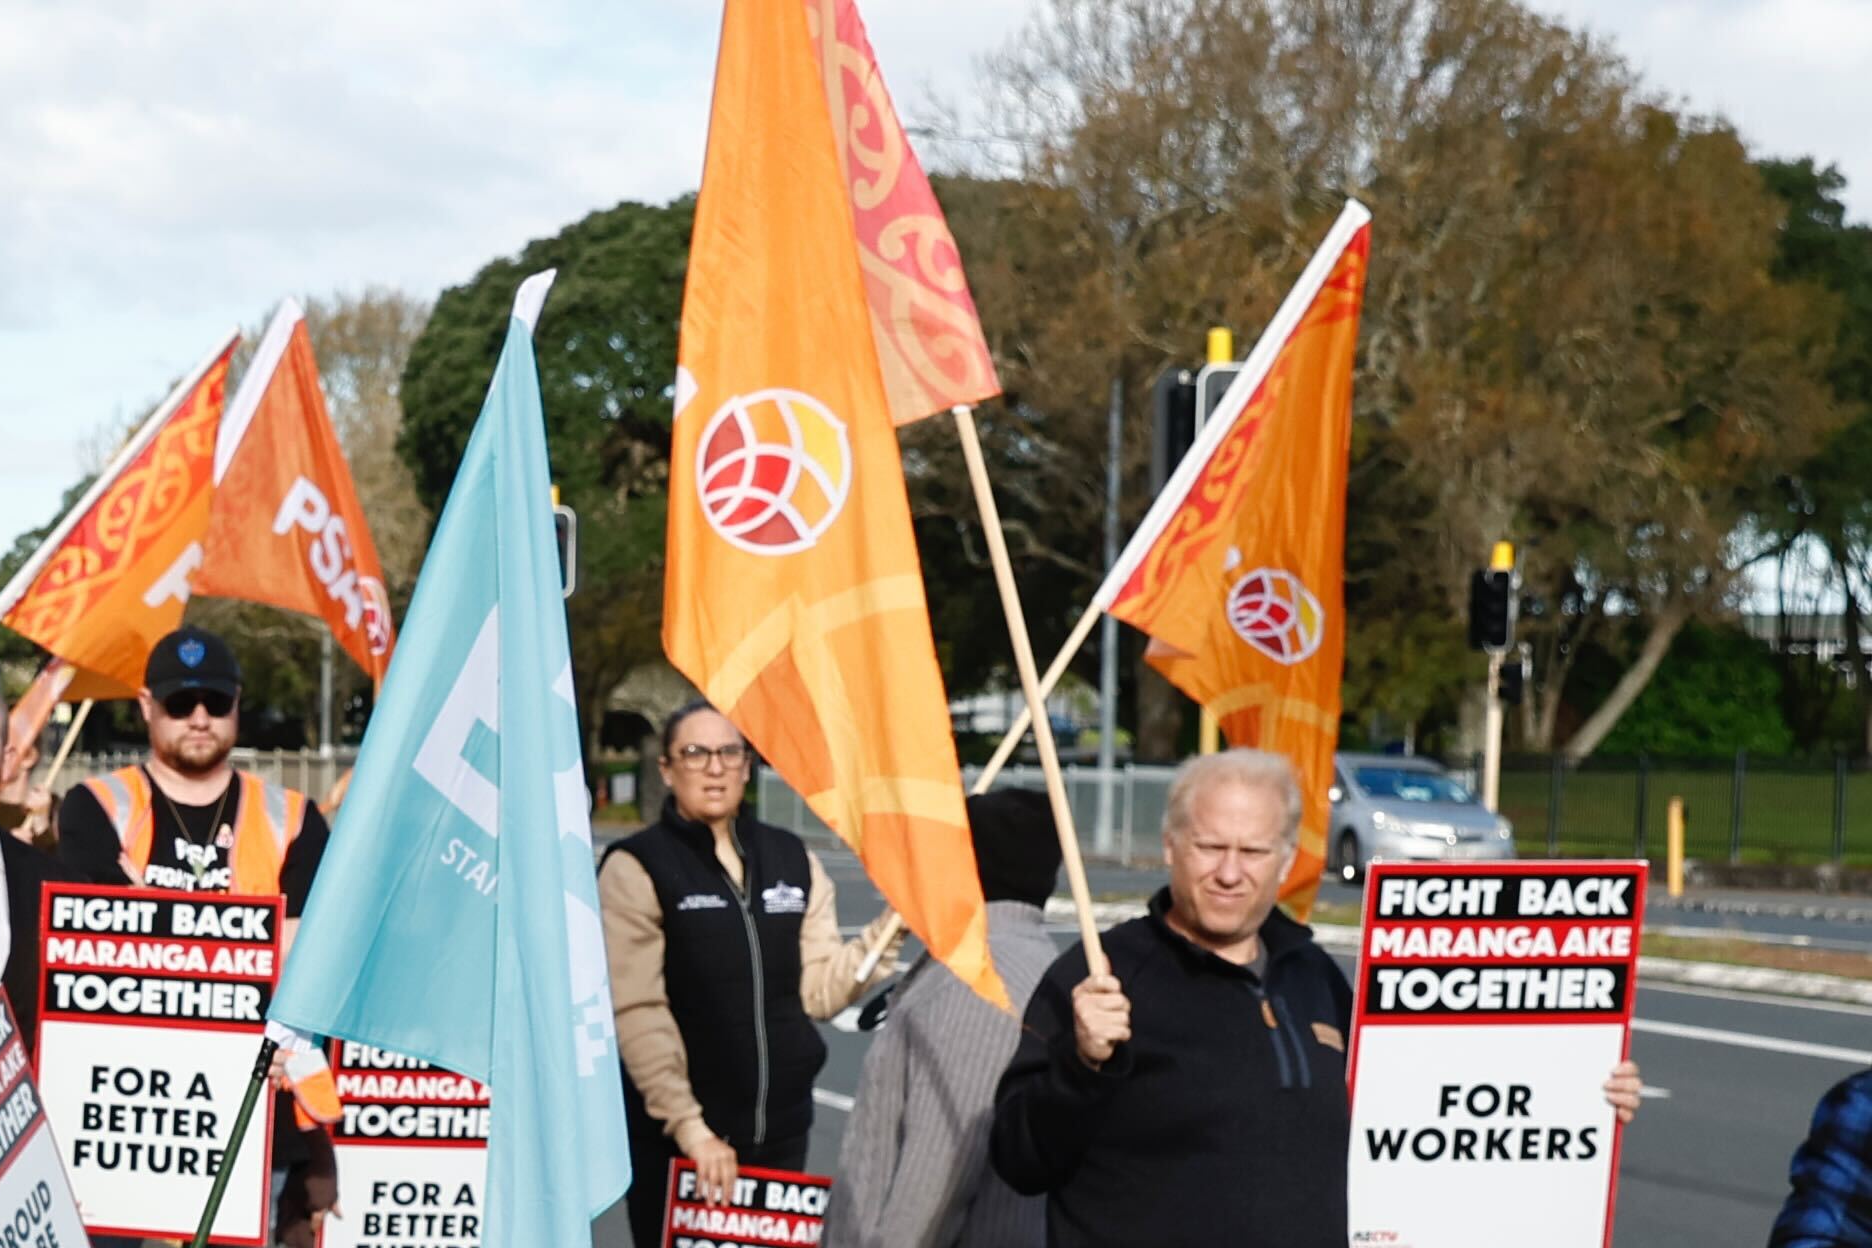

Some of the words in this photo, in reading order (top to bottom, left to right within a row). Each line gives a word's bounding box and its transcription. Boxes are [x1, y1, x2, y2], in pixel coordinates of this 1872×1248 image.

[1379, 878, 1503, 917] FIGHT
[1517, 878, 1630, 917] BACK
[52, 896, 158, 933] FIGHT
[171, 902, 271, 941] BACK
[46, 937, 208, 973] MARANGA
[209, 947, 274, 977] AKE
[1369, 926, 1558, 958] MARANGA
[1558, 926, 1632, 957] AKE
[52, 972, 262, 1021] TOGETHER
[1376, 968, 1616, 1011] TOGETHER
[90, 1065, 172, 1099] FOR
[185, 1072, 213, 1102] A
[336, 1074, 475, 1101] MARANGA
[1439, 1084, 1532, 1118] FOR
[81, 1102, 218, 1140] BETTER
[73, 1138, 226, 1178] FUTURE
[1365, 1126, 1599, 1162] WORKERS
[371, 1181, 441, 1207] FOR
[452, 1183, 476, 1207] A
[363, 1213, 479, 1239] BETTER
[672, 1206, 791, 1242] MARANGA
